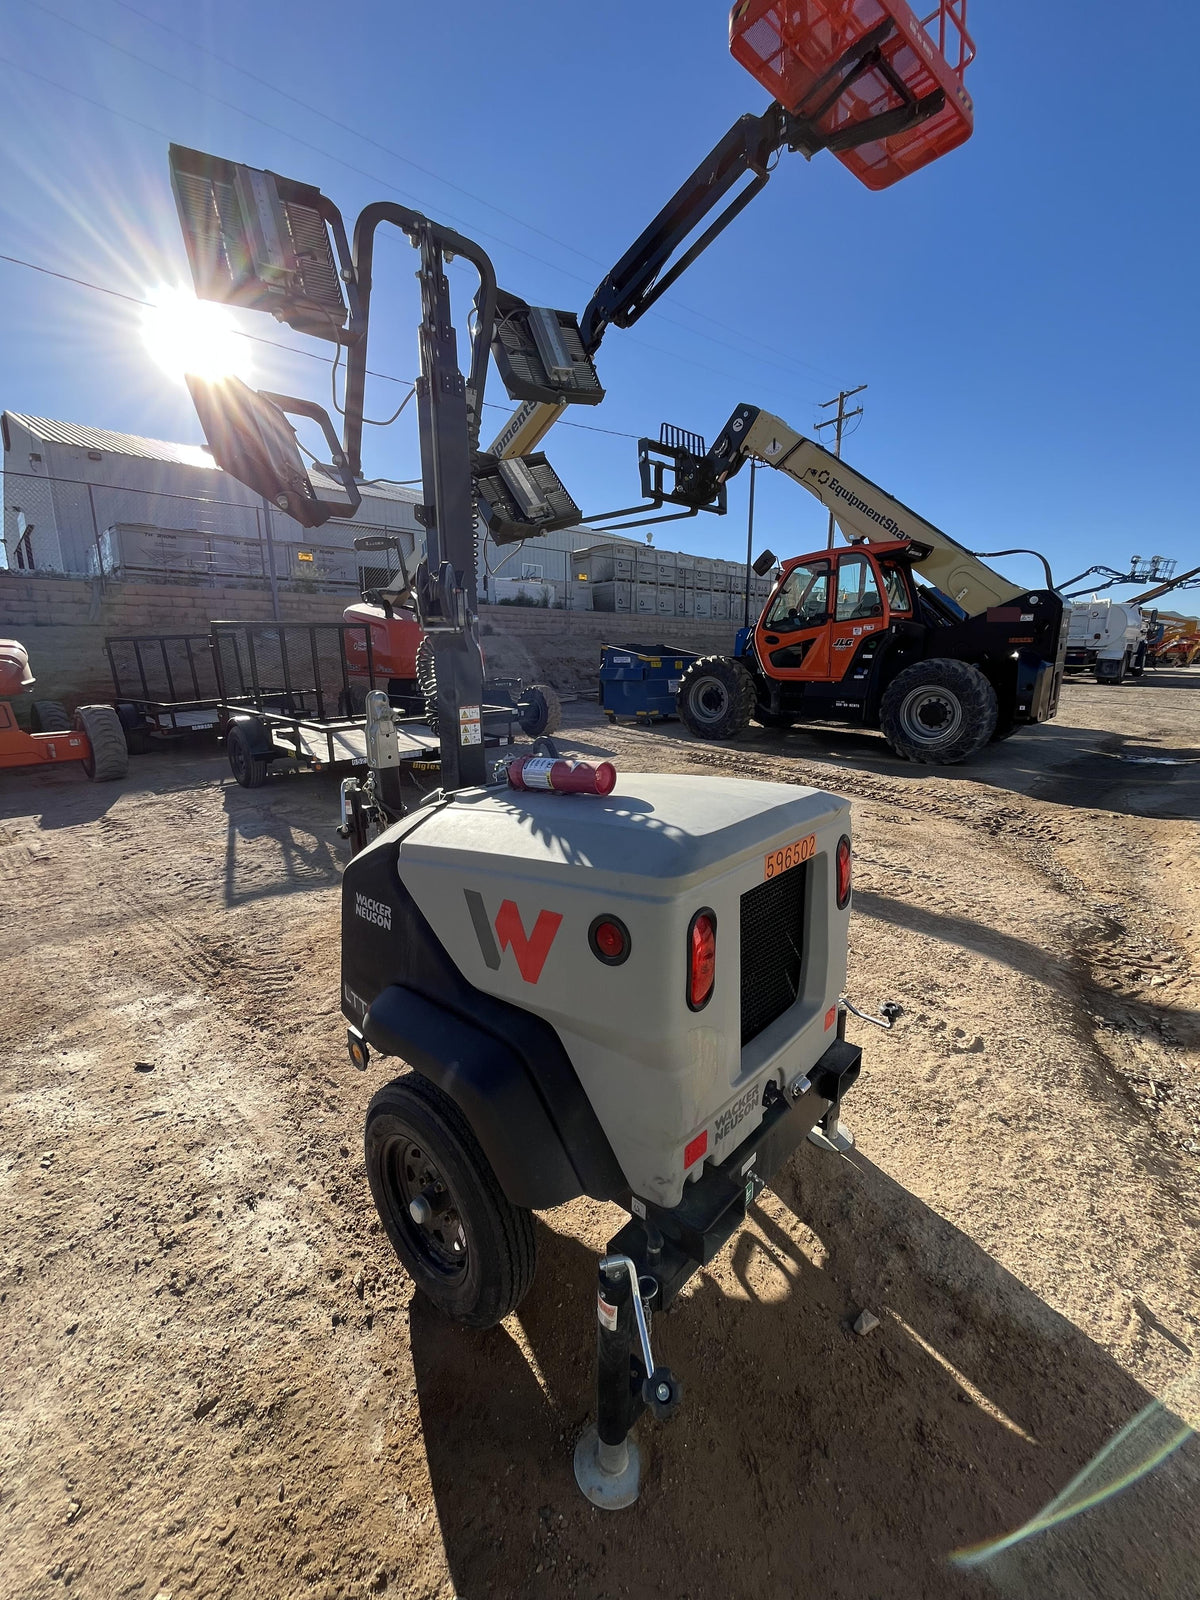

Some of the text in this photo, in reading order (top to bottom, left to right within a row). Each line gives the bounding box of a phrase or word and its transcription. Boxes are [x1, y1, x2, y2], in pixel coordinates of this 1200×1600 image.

[828, 477, 914, 541] EquipmentShar
[833, 638, 854, 647] JLG
[766, 835, 815, 878] 596502
[355, 891, 392, 919] WACKER
[355, 903, 392, 931] NEUSON
[714, 1083, 759, 1130] WACKER
[714, 1094, 760, 1145] NEUSON
